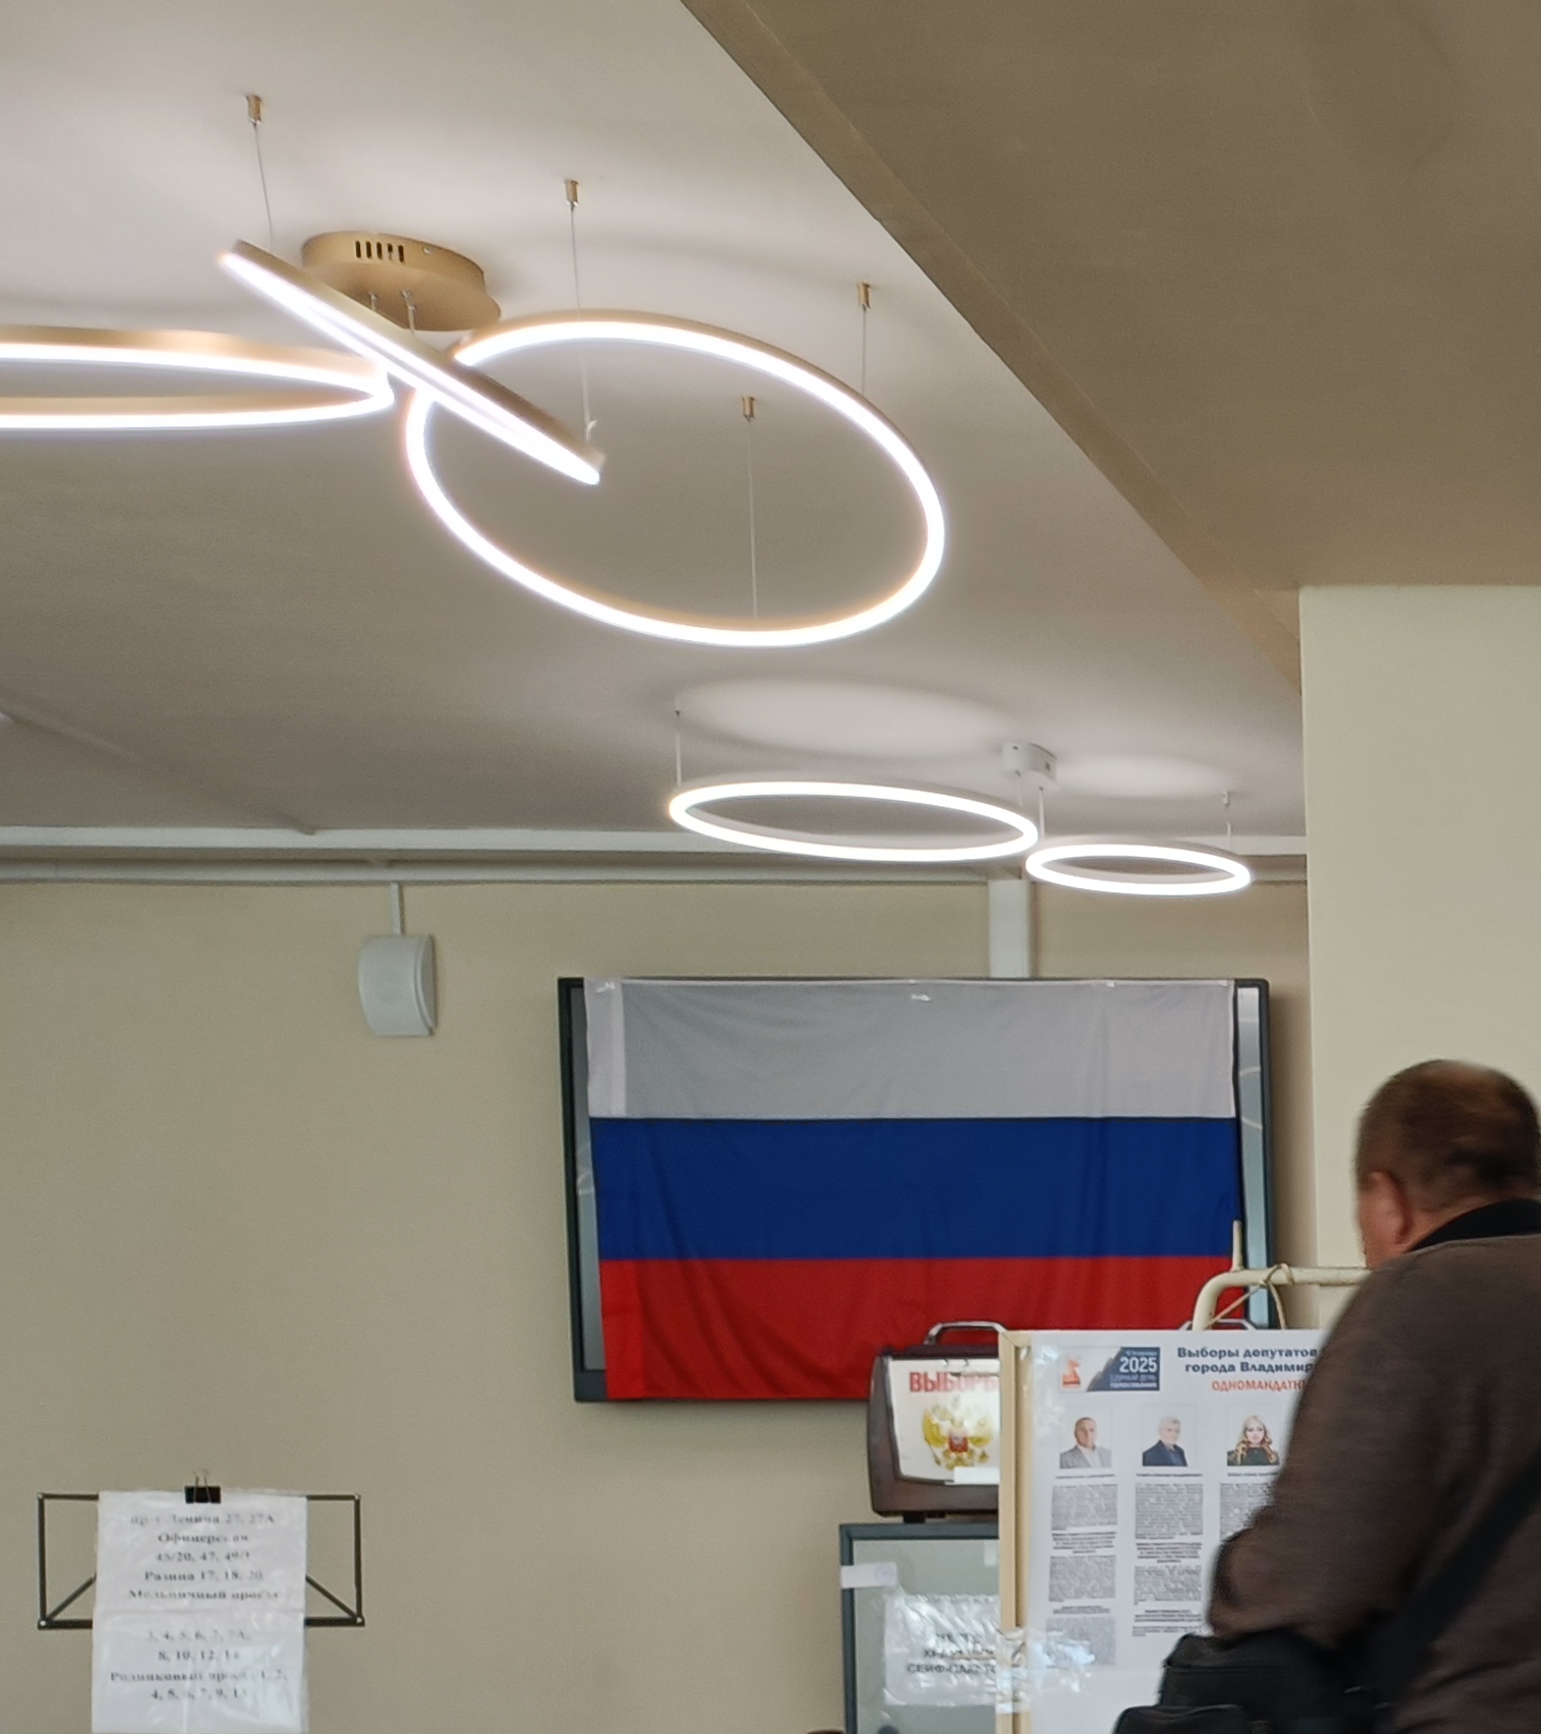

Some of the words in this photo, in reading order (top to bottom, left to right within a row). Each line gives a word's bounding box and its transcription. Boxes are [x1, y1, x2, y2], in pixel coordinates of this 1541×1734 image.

[1177, 1346, 1239, 1360] Выборы
[1243, 1348, 1318, 1360] депутатов
[1119, 1356, 1158, 1373] 2025
[1185, 1364, 1236, 1375] города
[1240, 1361, 1315, 1374] Владимир
[1211, 1379, 1306, 1393] ОДНОМАНДАТН
